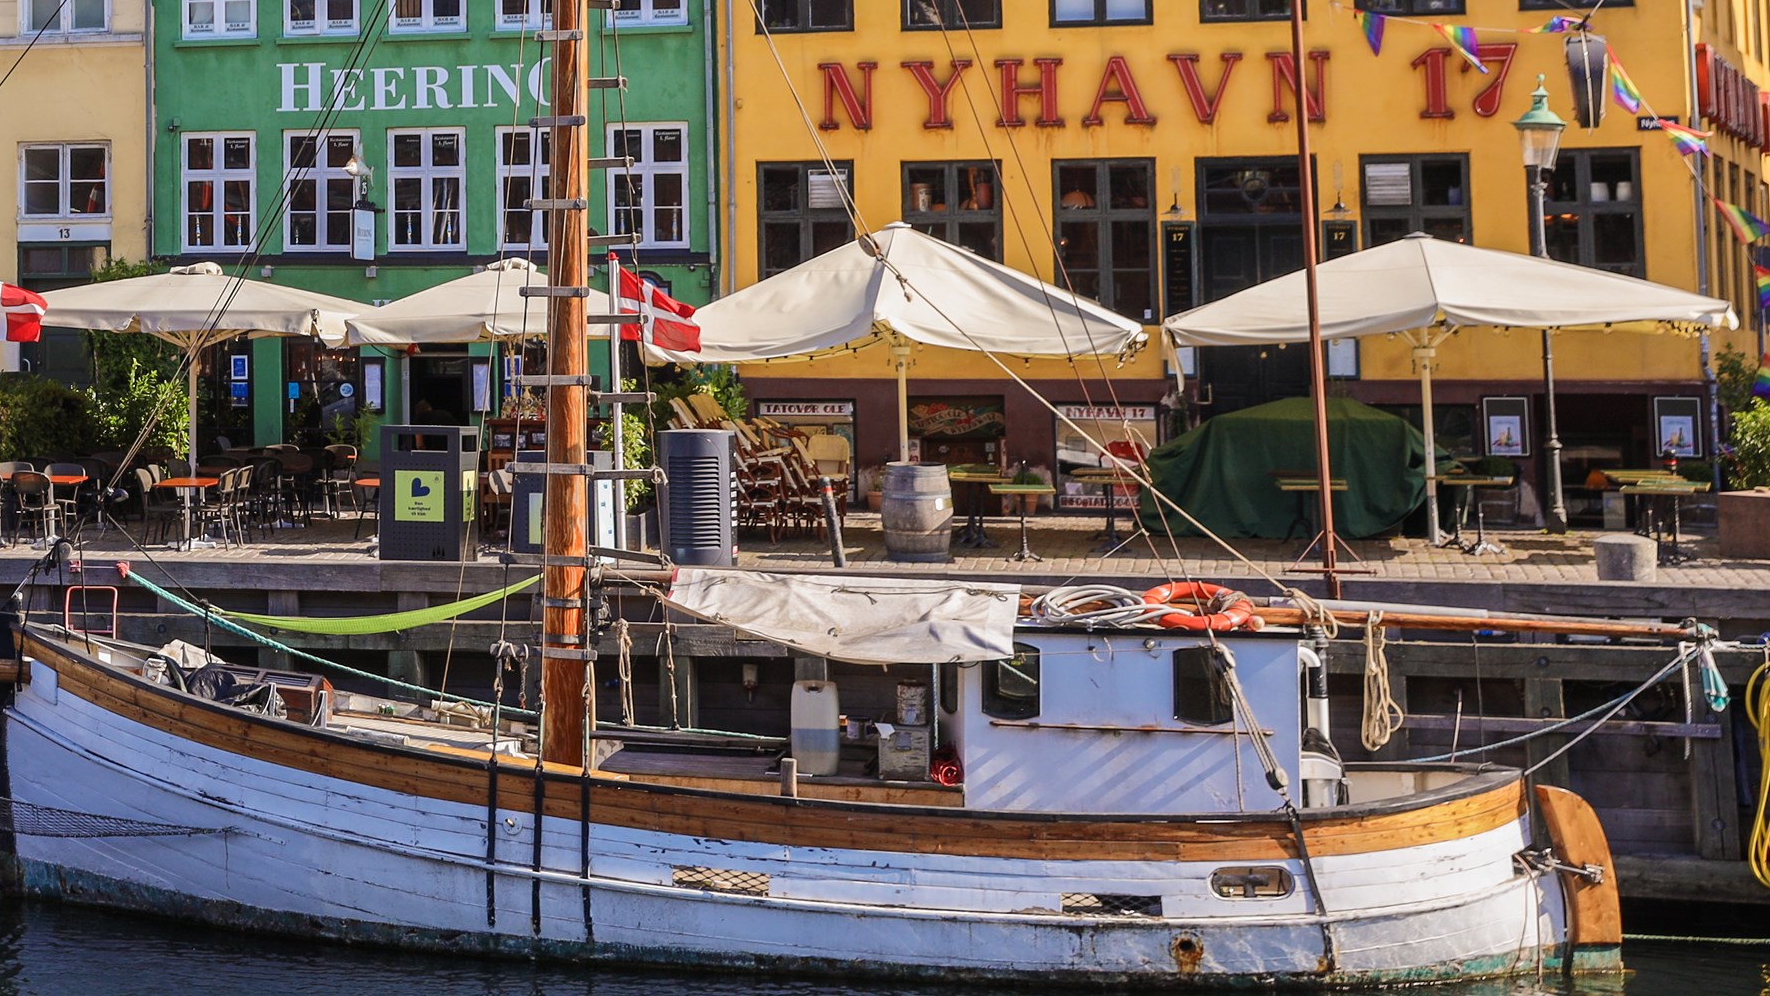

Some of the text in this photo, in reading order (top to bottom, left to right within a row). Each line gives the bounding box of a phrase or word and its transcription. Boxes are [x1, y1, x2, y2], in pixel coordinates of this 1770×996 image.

[818, 43, 1518, 130] NYHAVN 17
[59, 228, 71, 239] 13
[1172, 232, 1184, 242] 17
[1333, 231, 1346, 241] 17
[823, 404, 846, 414] OLE
[1132, 408, 1146, 418] 17
